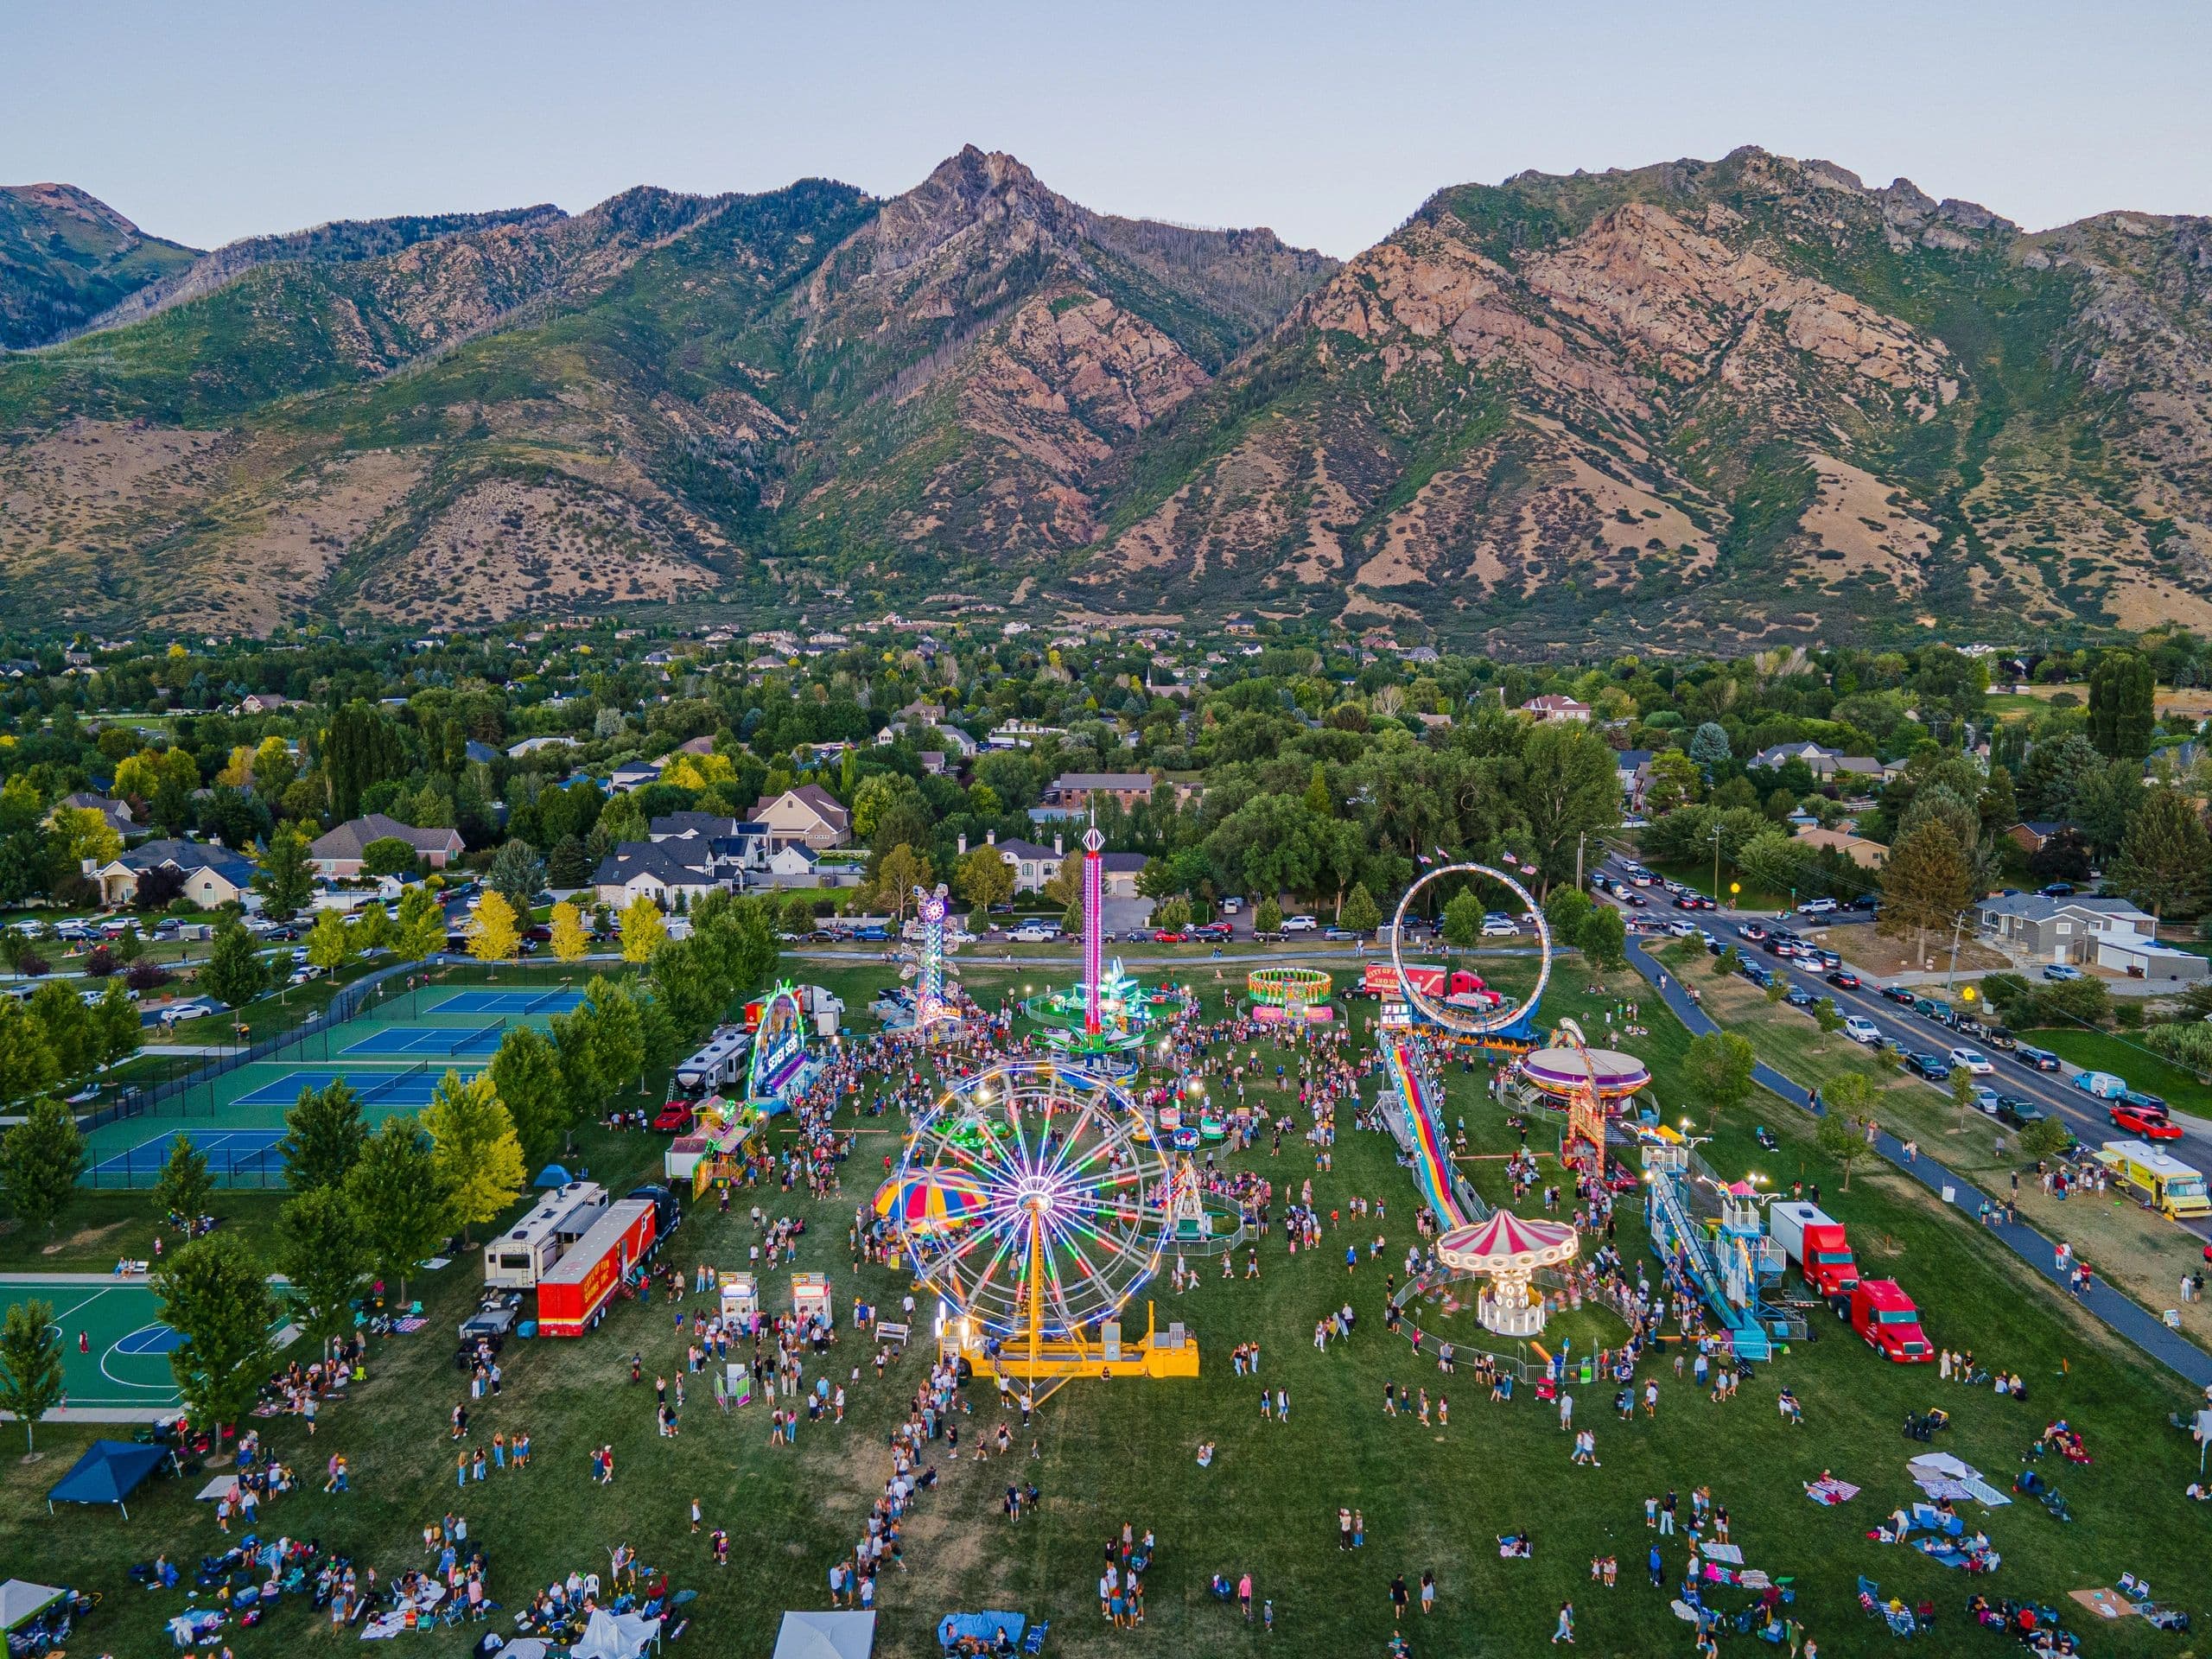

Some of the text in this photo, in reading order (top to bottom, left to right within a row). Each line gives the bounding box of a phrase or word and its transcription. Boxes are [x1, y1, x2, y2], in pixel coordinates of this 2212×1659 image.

[1367, 968, 1382, 978] CITY
[1385, 1005, 1408, 1014] FUN
[768, 1033, 798, 1073] SEVEN SEAS
[584, 1272, 594, 1291] CITY
[595, 1263, 601, 1275] OF
[585, 1281, 599, 1303] SHOWS
